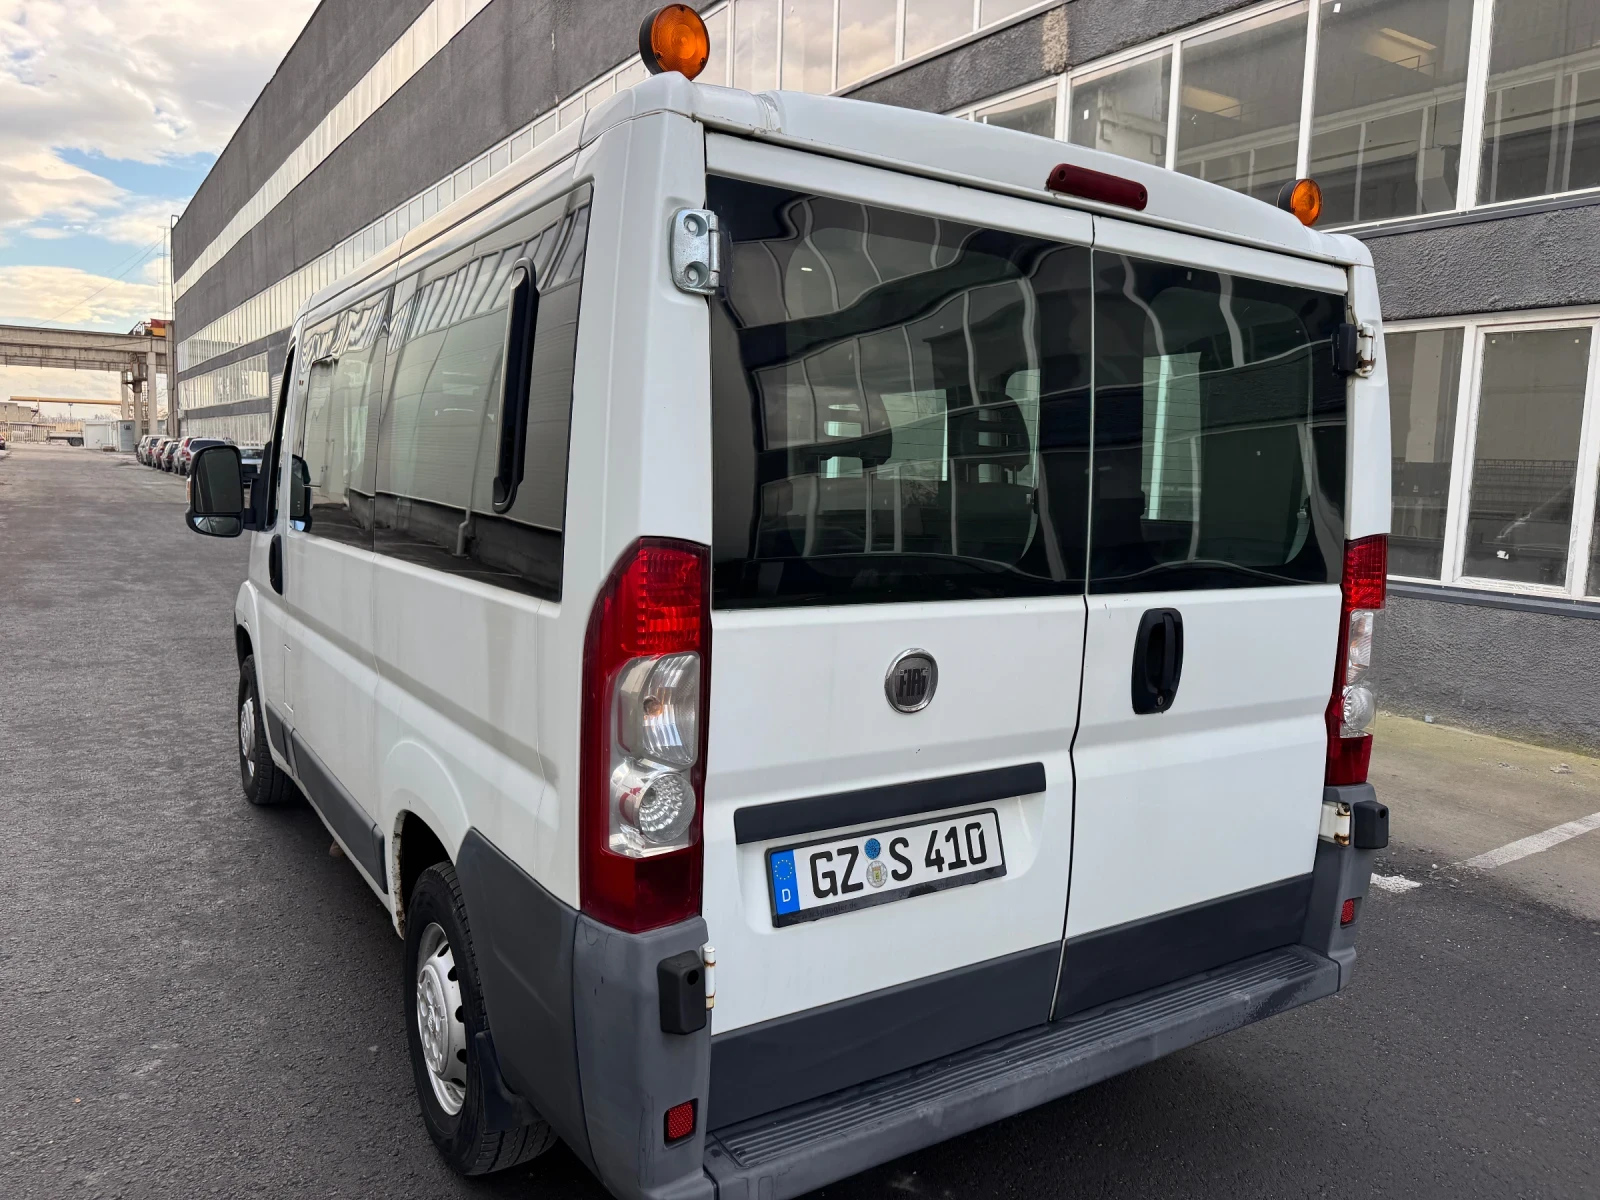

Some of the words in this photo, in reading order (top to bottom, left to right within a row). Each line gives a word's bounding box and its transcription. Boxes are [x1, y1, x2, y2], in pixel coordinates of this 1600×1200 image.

[897, 667, 929, 697] FIAT
[809, 845, 864, 899] GZ
[889, 837, 913, 882] S
[924, 821, 988, 873] 410
[781, 888, 792, 903] D
